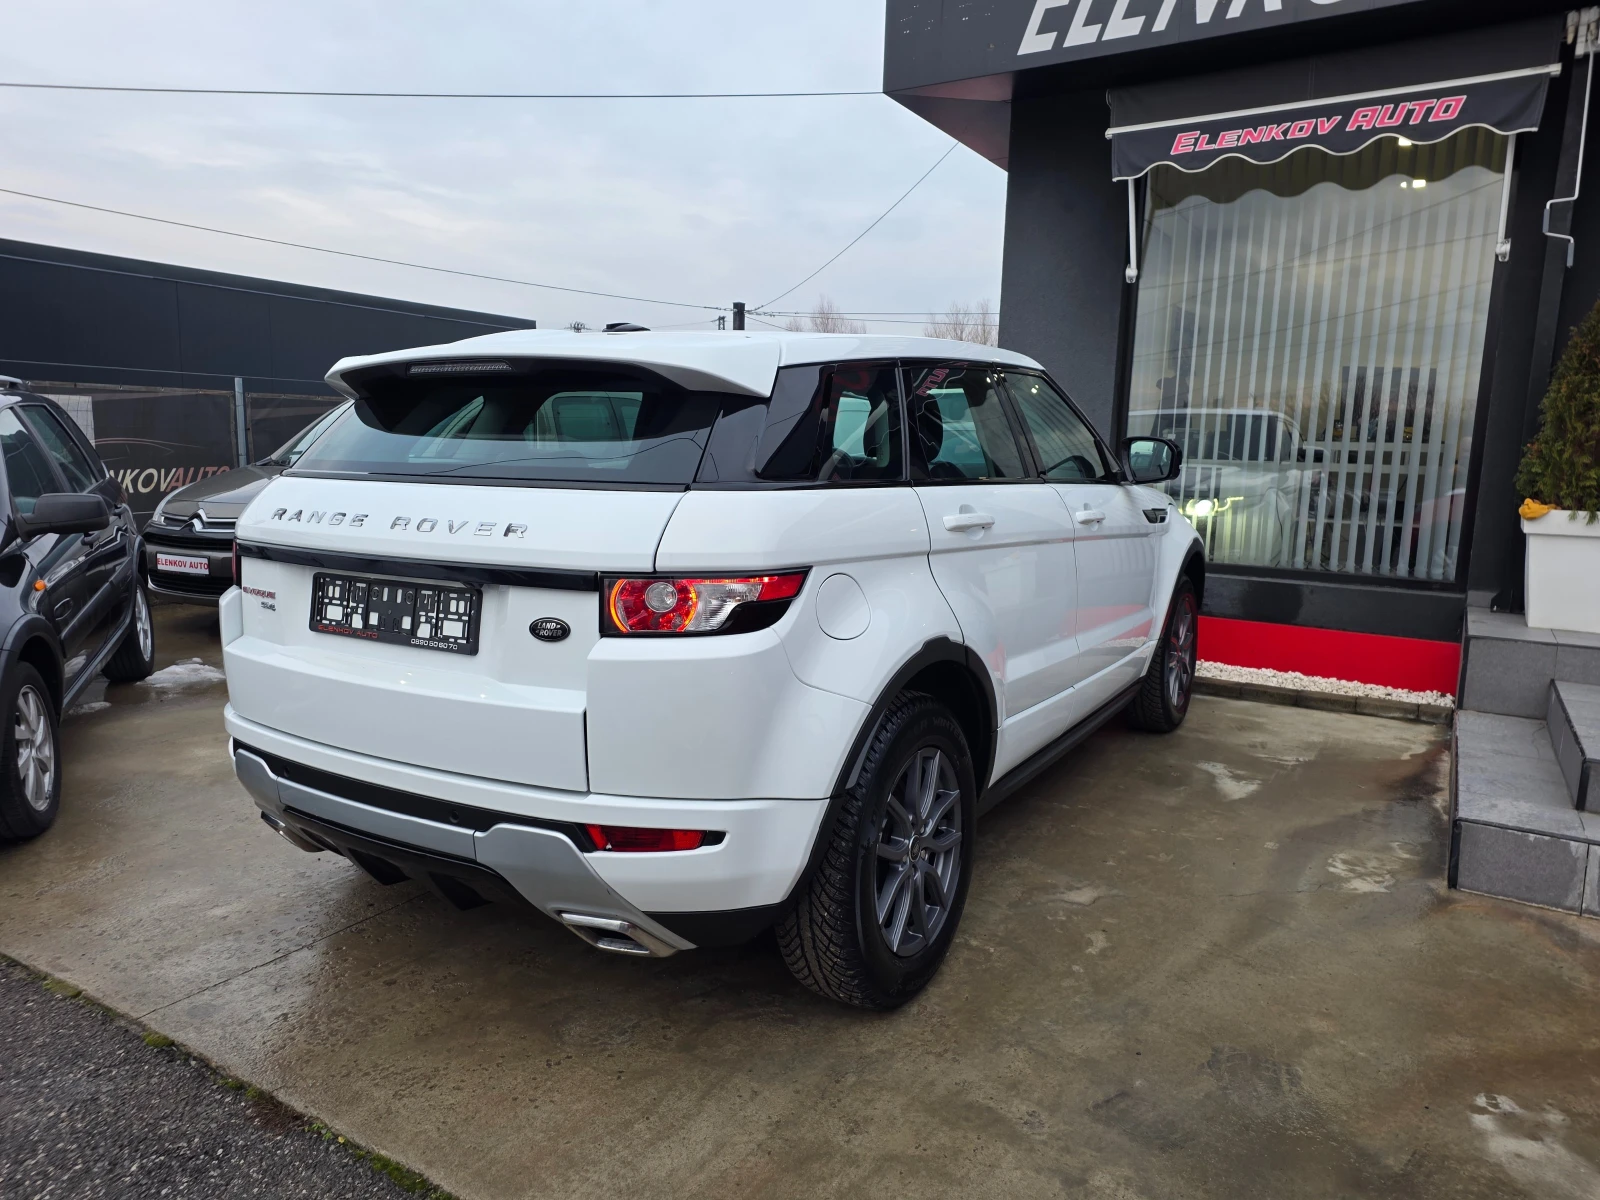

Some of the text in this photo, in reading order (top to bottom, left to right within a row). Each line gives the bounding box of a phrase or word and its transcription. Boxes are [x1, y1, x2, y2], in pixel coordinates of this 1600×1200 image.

[1170, 95, 1467, 155] ELENKOV AUTO
[271, 508, 528, 538] RANGE ROVER
[157, 558, 209, 570] ELENKOV AUTO
[318, 625, 378, 639] ELENKOV AUTO
